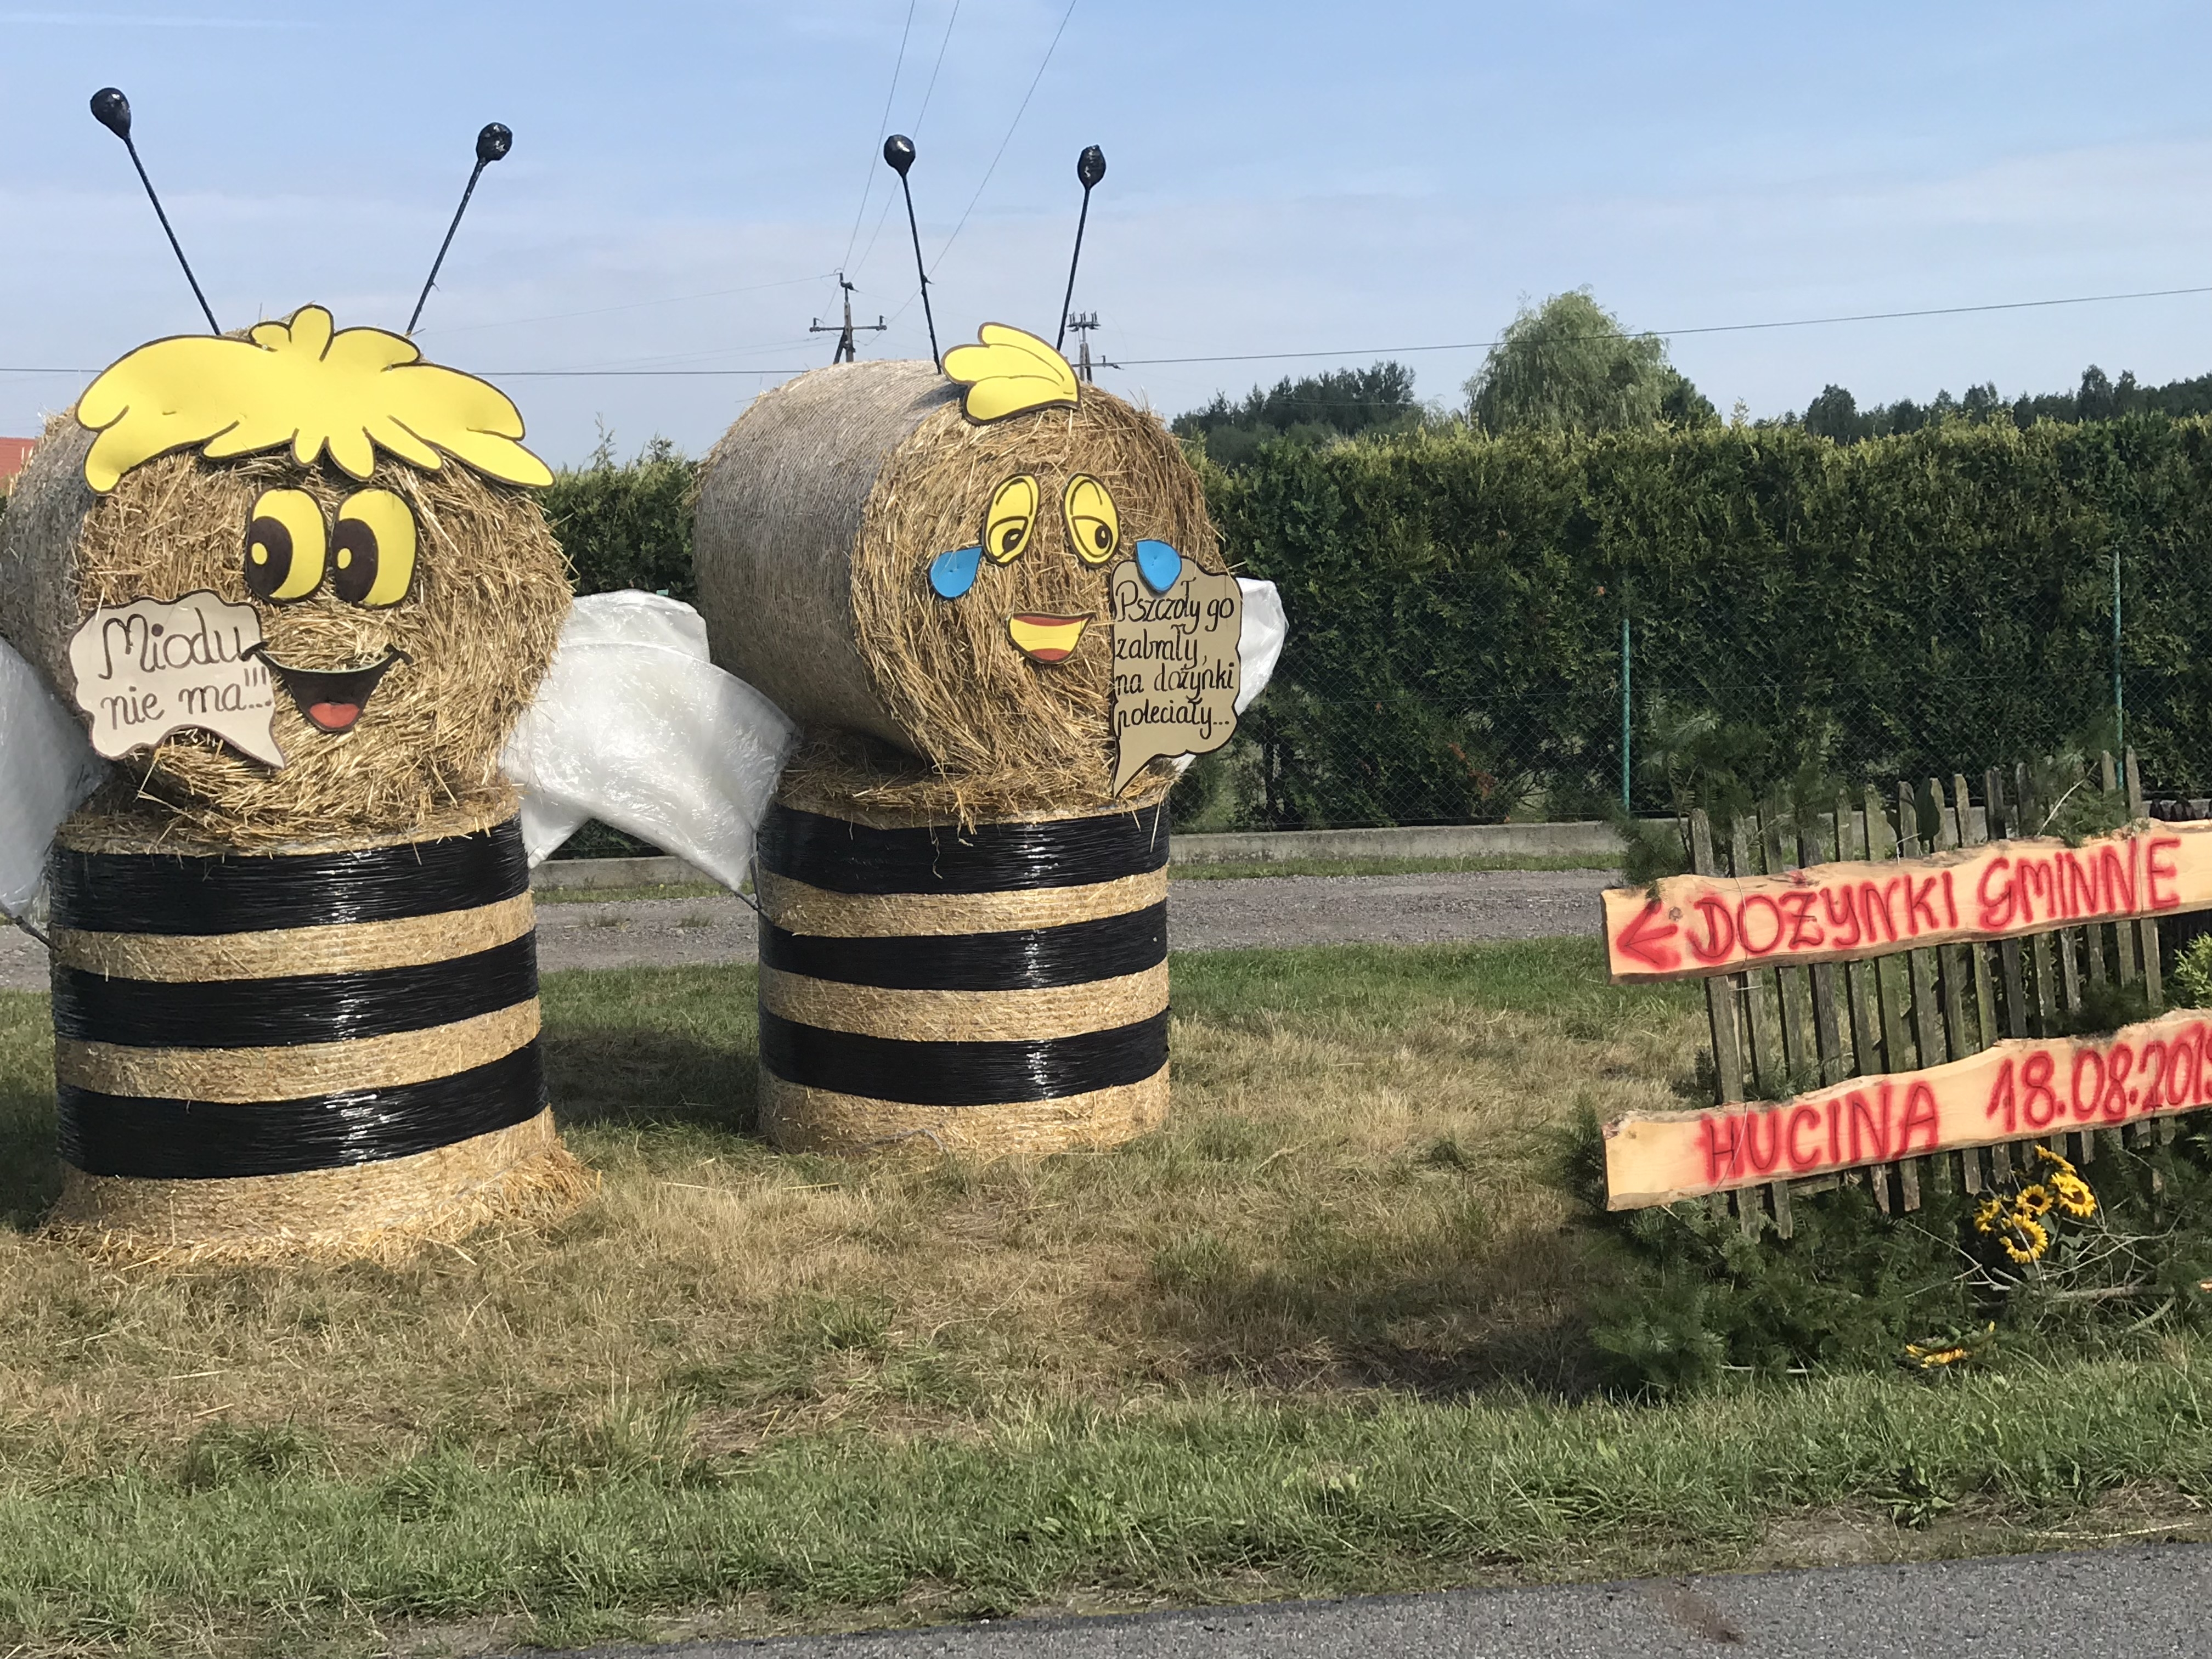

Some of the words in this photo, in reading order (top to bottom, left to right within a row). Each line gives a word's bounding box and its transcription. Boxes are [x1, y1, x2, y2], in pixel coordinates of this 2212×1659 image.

[98, 607, 245, 679] Miodu
[1205, 598, 1234, 631] go
[100, 686, 165, 730] nie
[1115, 674, 1144, 695] na
[1154, 659, 1234, 700] dożynki
[1979, 837, 2182, 931] GMINNE
[1701, 1080, 1939, 1183] HUCINA
[1986, 1022, 2212, 1133] 18.08.201
